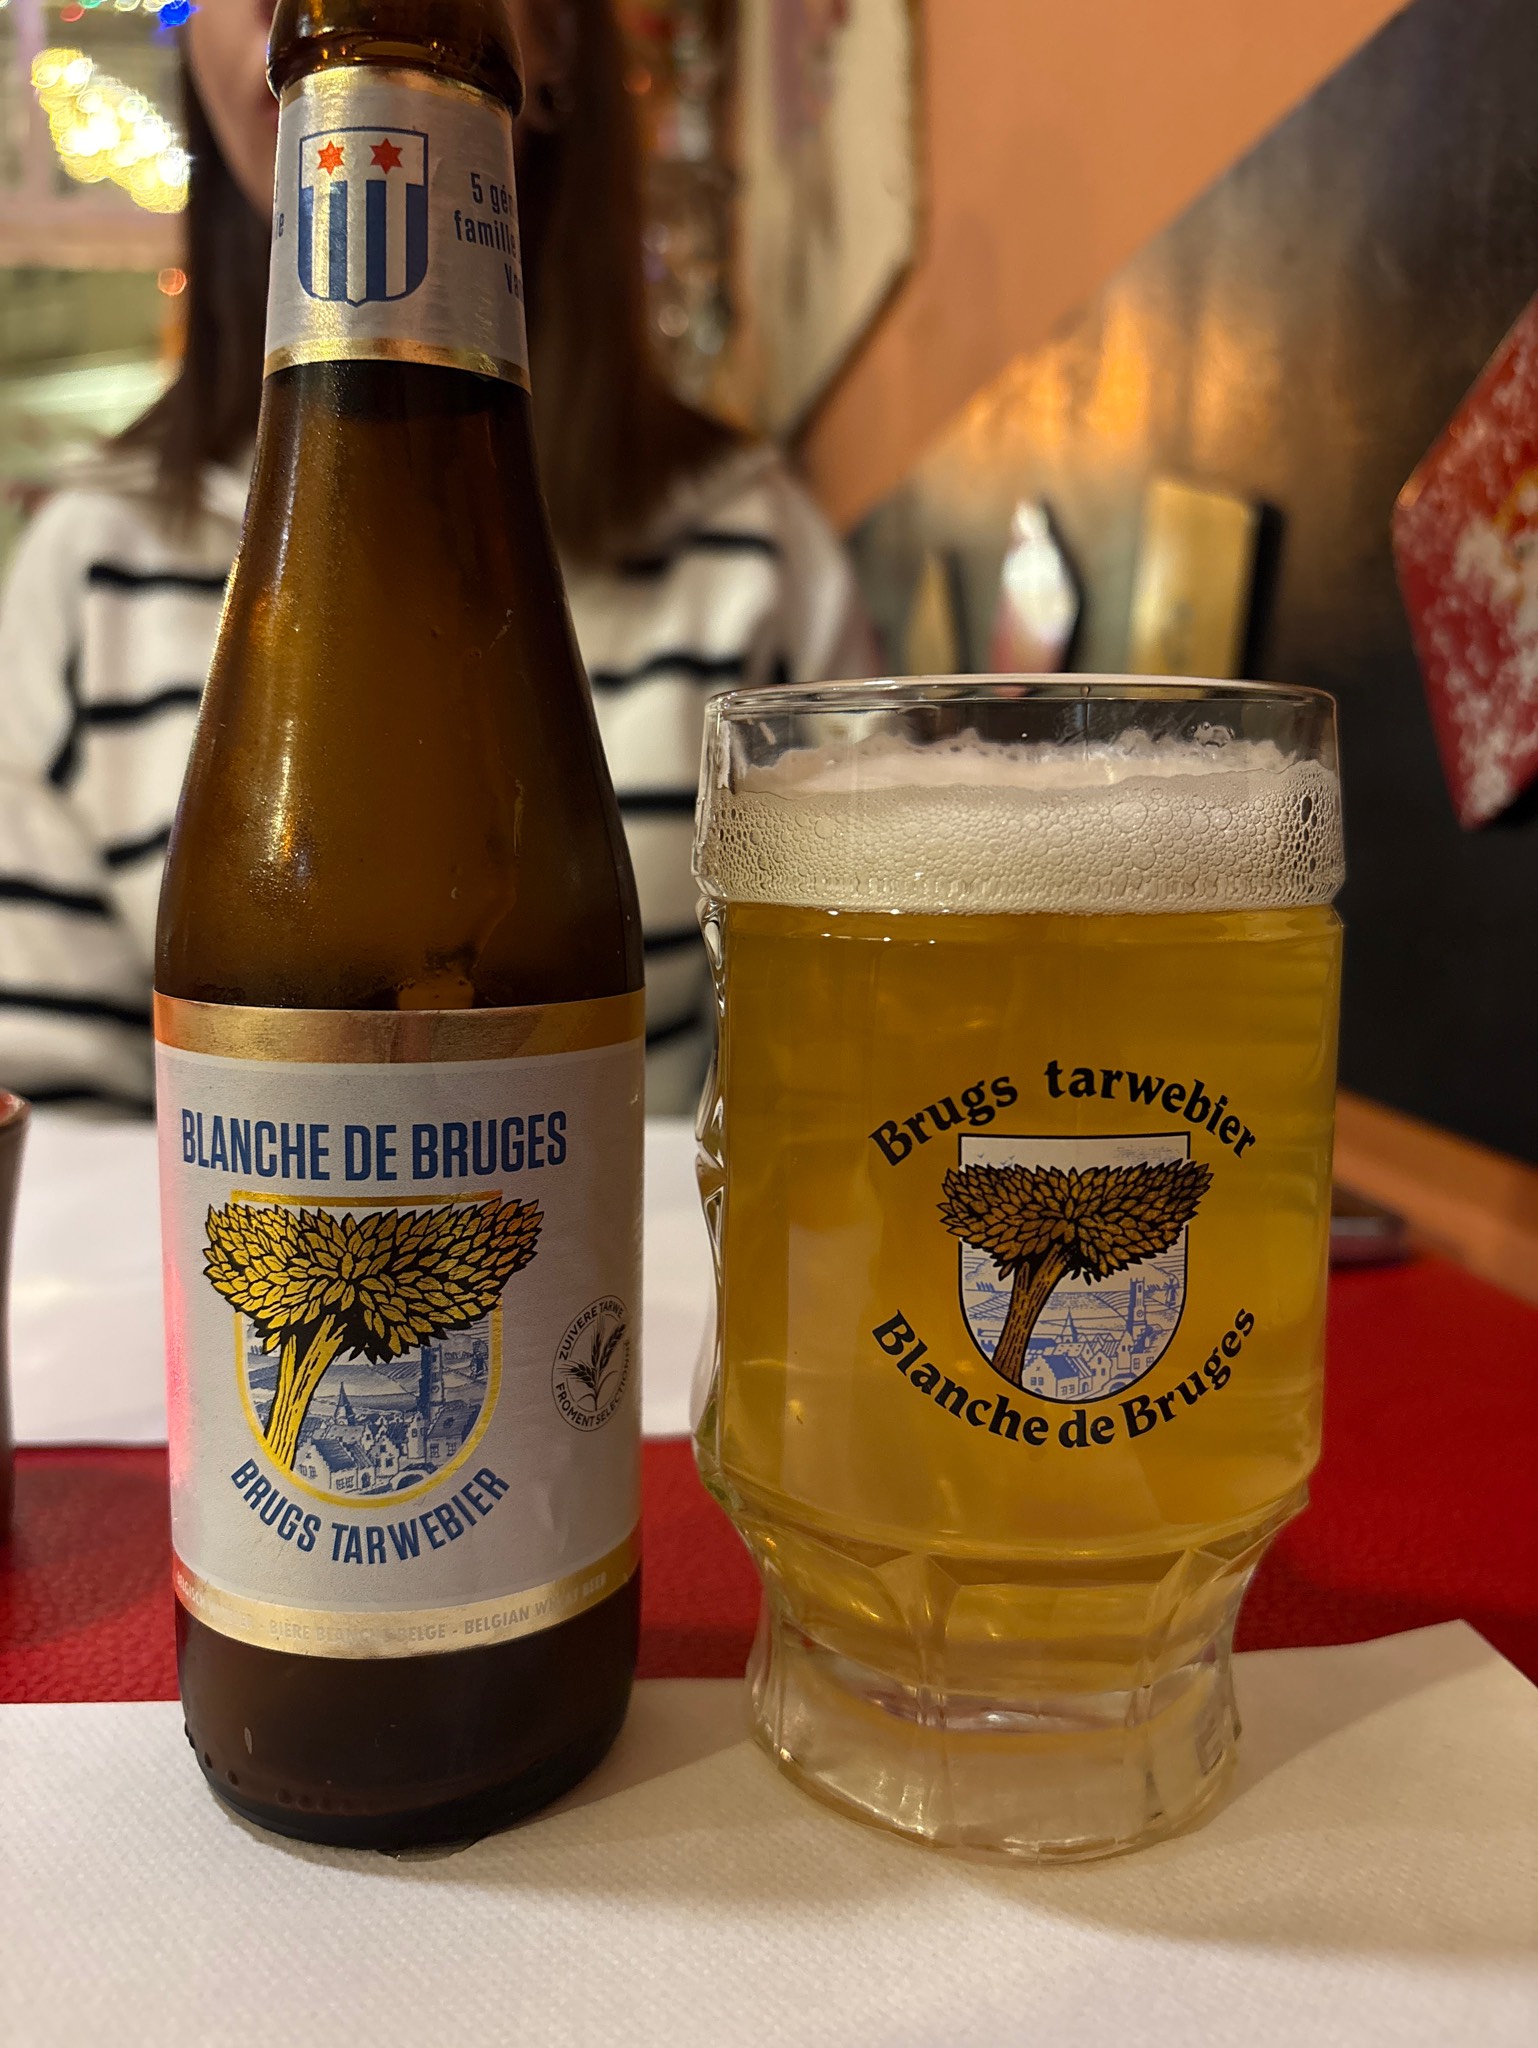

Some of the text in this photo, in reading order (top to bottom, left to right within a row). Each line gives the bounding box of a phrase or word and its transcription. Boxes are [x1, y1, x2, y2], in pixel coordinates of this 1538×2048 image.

[470, 172, 484, 205] 5
[181, 1109, 568, 1182] BLANCHE DE BRUGES
[868, 1060, 1256, 1167] Brugs tarwebier
[558, 1300, 624, 1361] ZUIVERE TARWE
[555, 1382, 596, 1427] FROMENT
[871, 1307, 1256, 1449] Blanche de Bruges
[230, 1458, 511, 1566] BRUGS TARWEBIER
[269, 1618, 310, 1640] BIÈRE
[463, 1606, 530, 1635] BELGIAN
